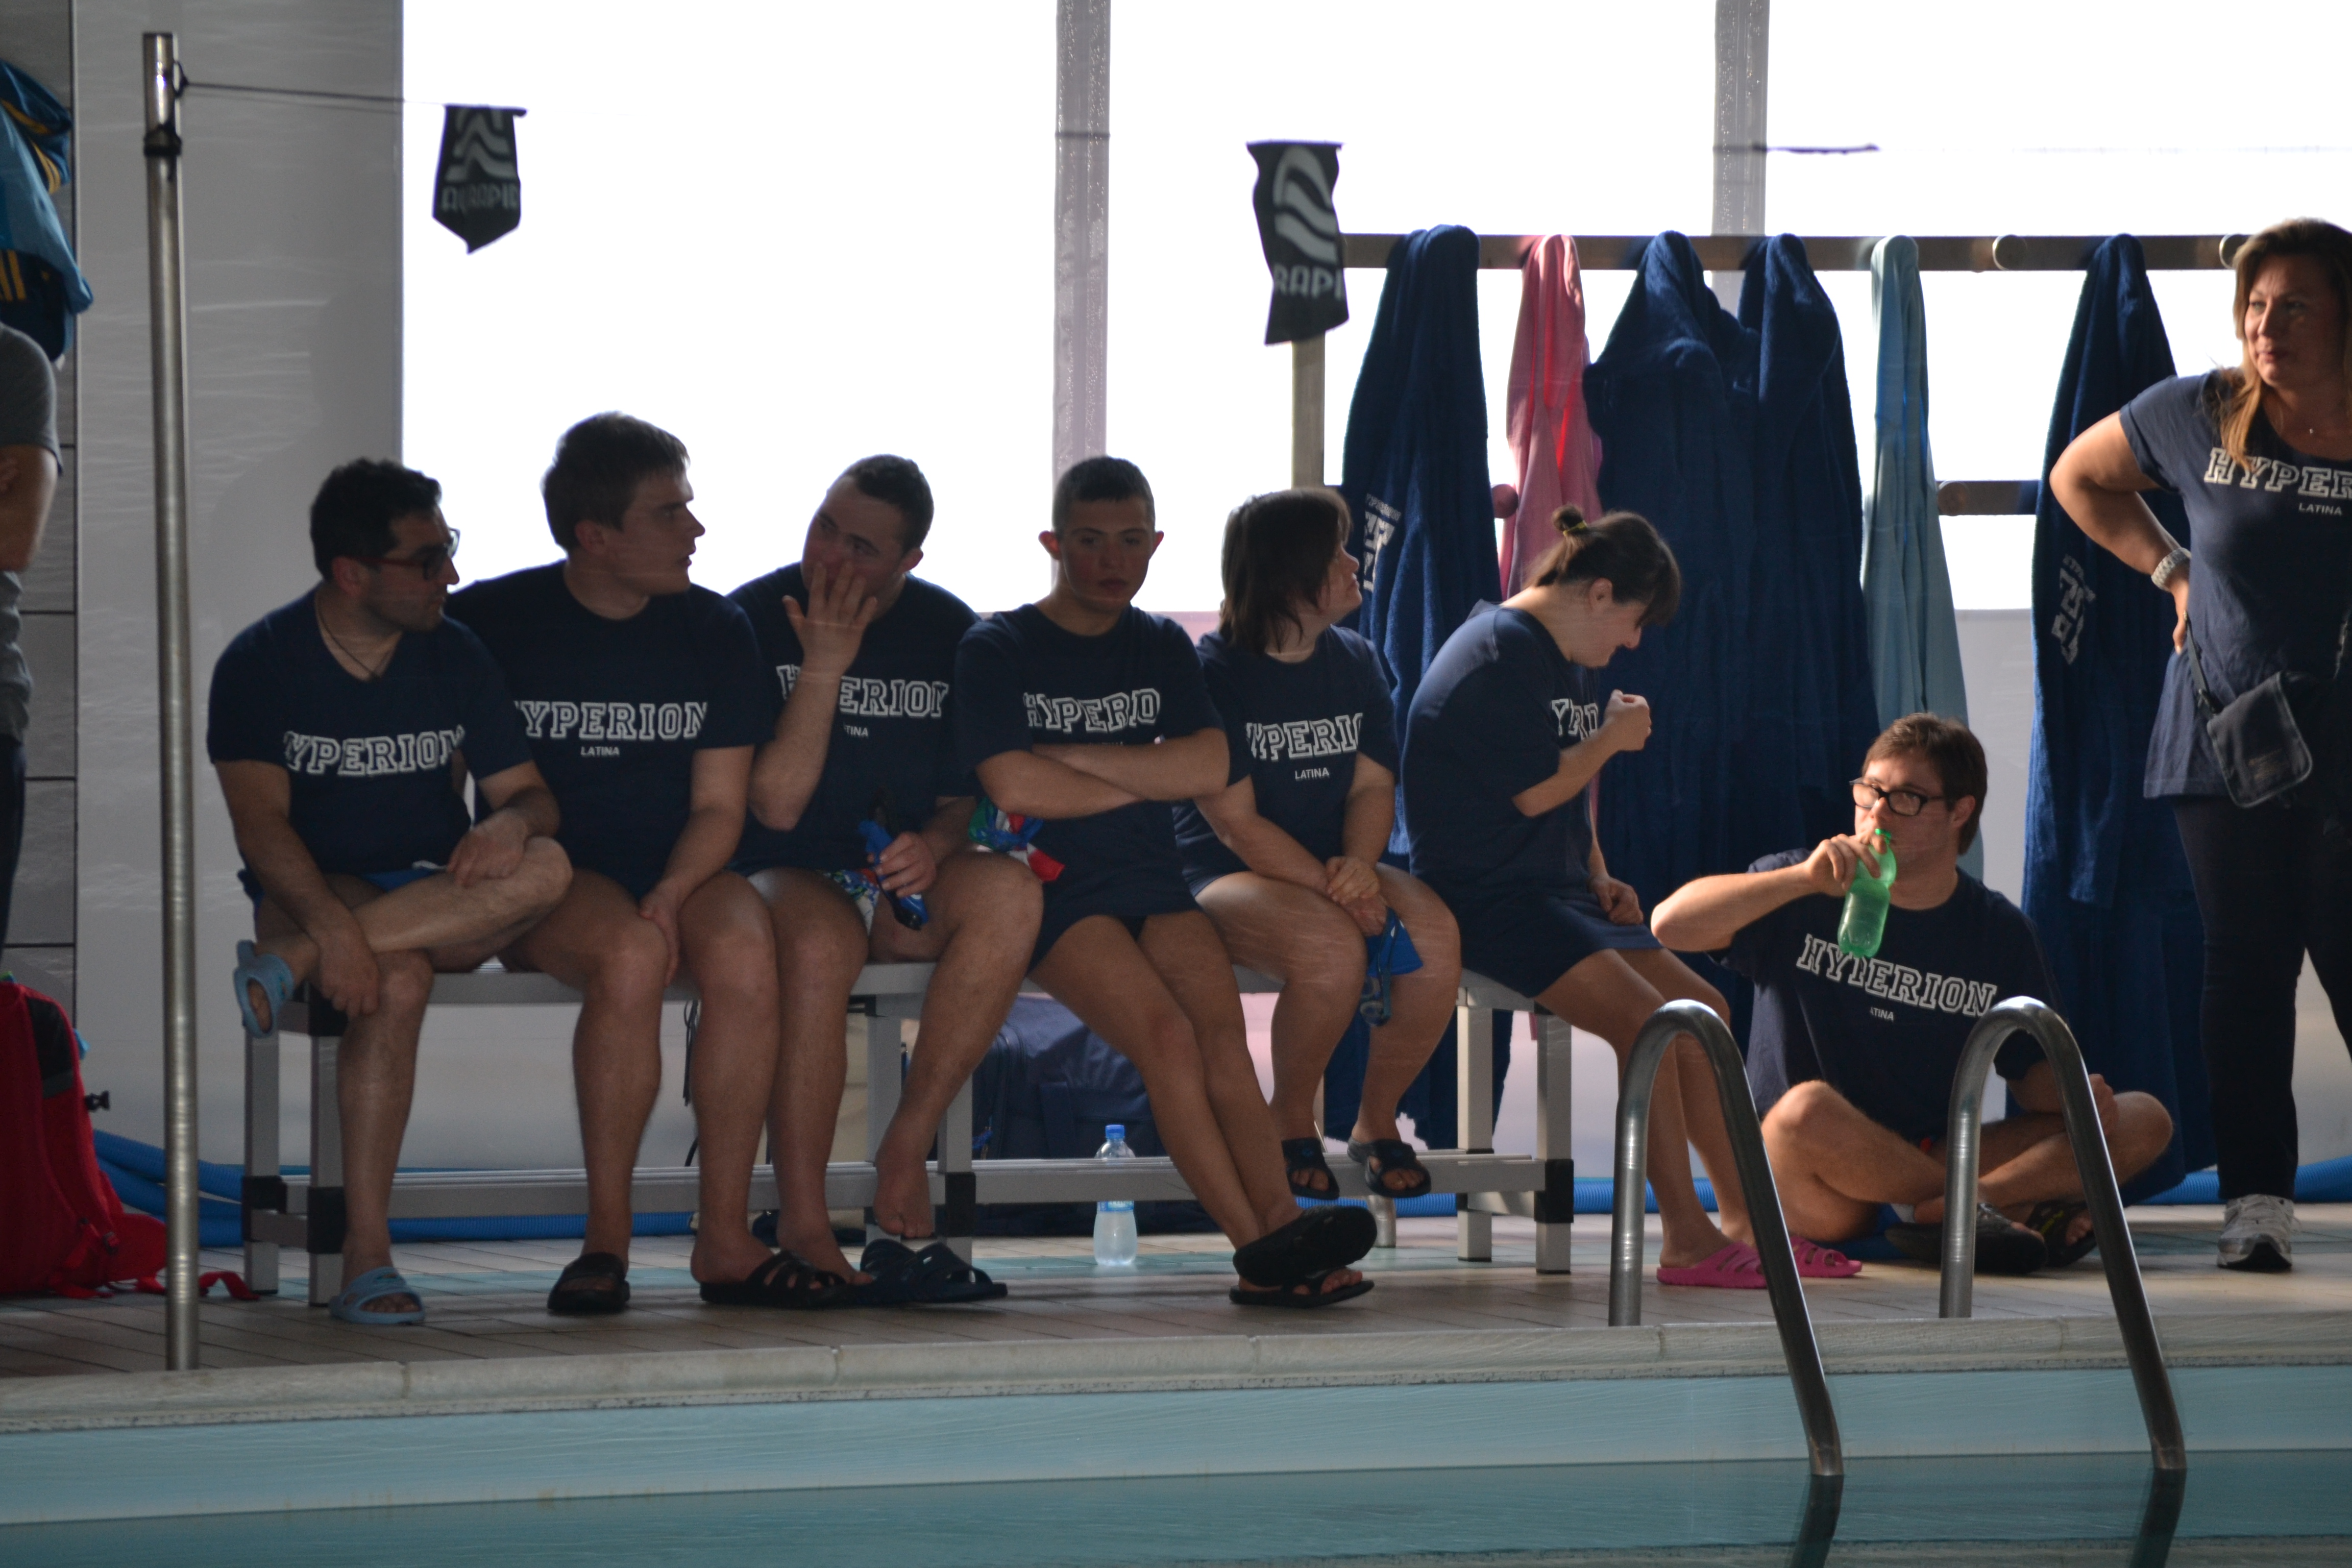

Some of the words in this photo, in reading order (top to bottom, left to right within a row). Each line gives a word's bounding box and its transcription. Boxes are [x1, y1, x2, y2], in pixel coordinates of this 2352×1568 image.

[2298, 502, 2342, 516] LATINA
[775, 664, 949, 717] HERION
[513, 700, 707, 740] YPERION
[844, 724, 869, 738] TINA
[580, 746, 620, 756] LATINA
[1295, 767, 1330, 781] LATINA
